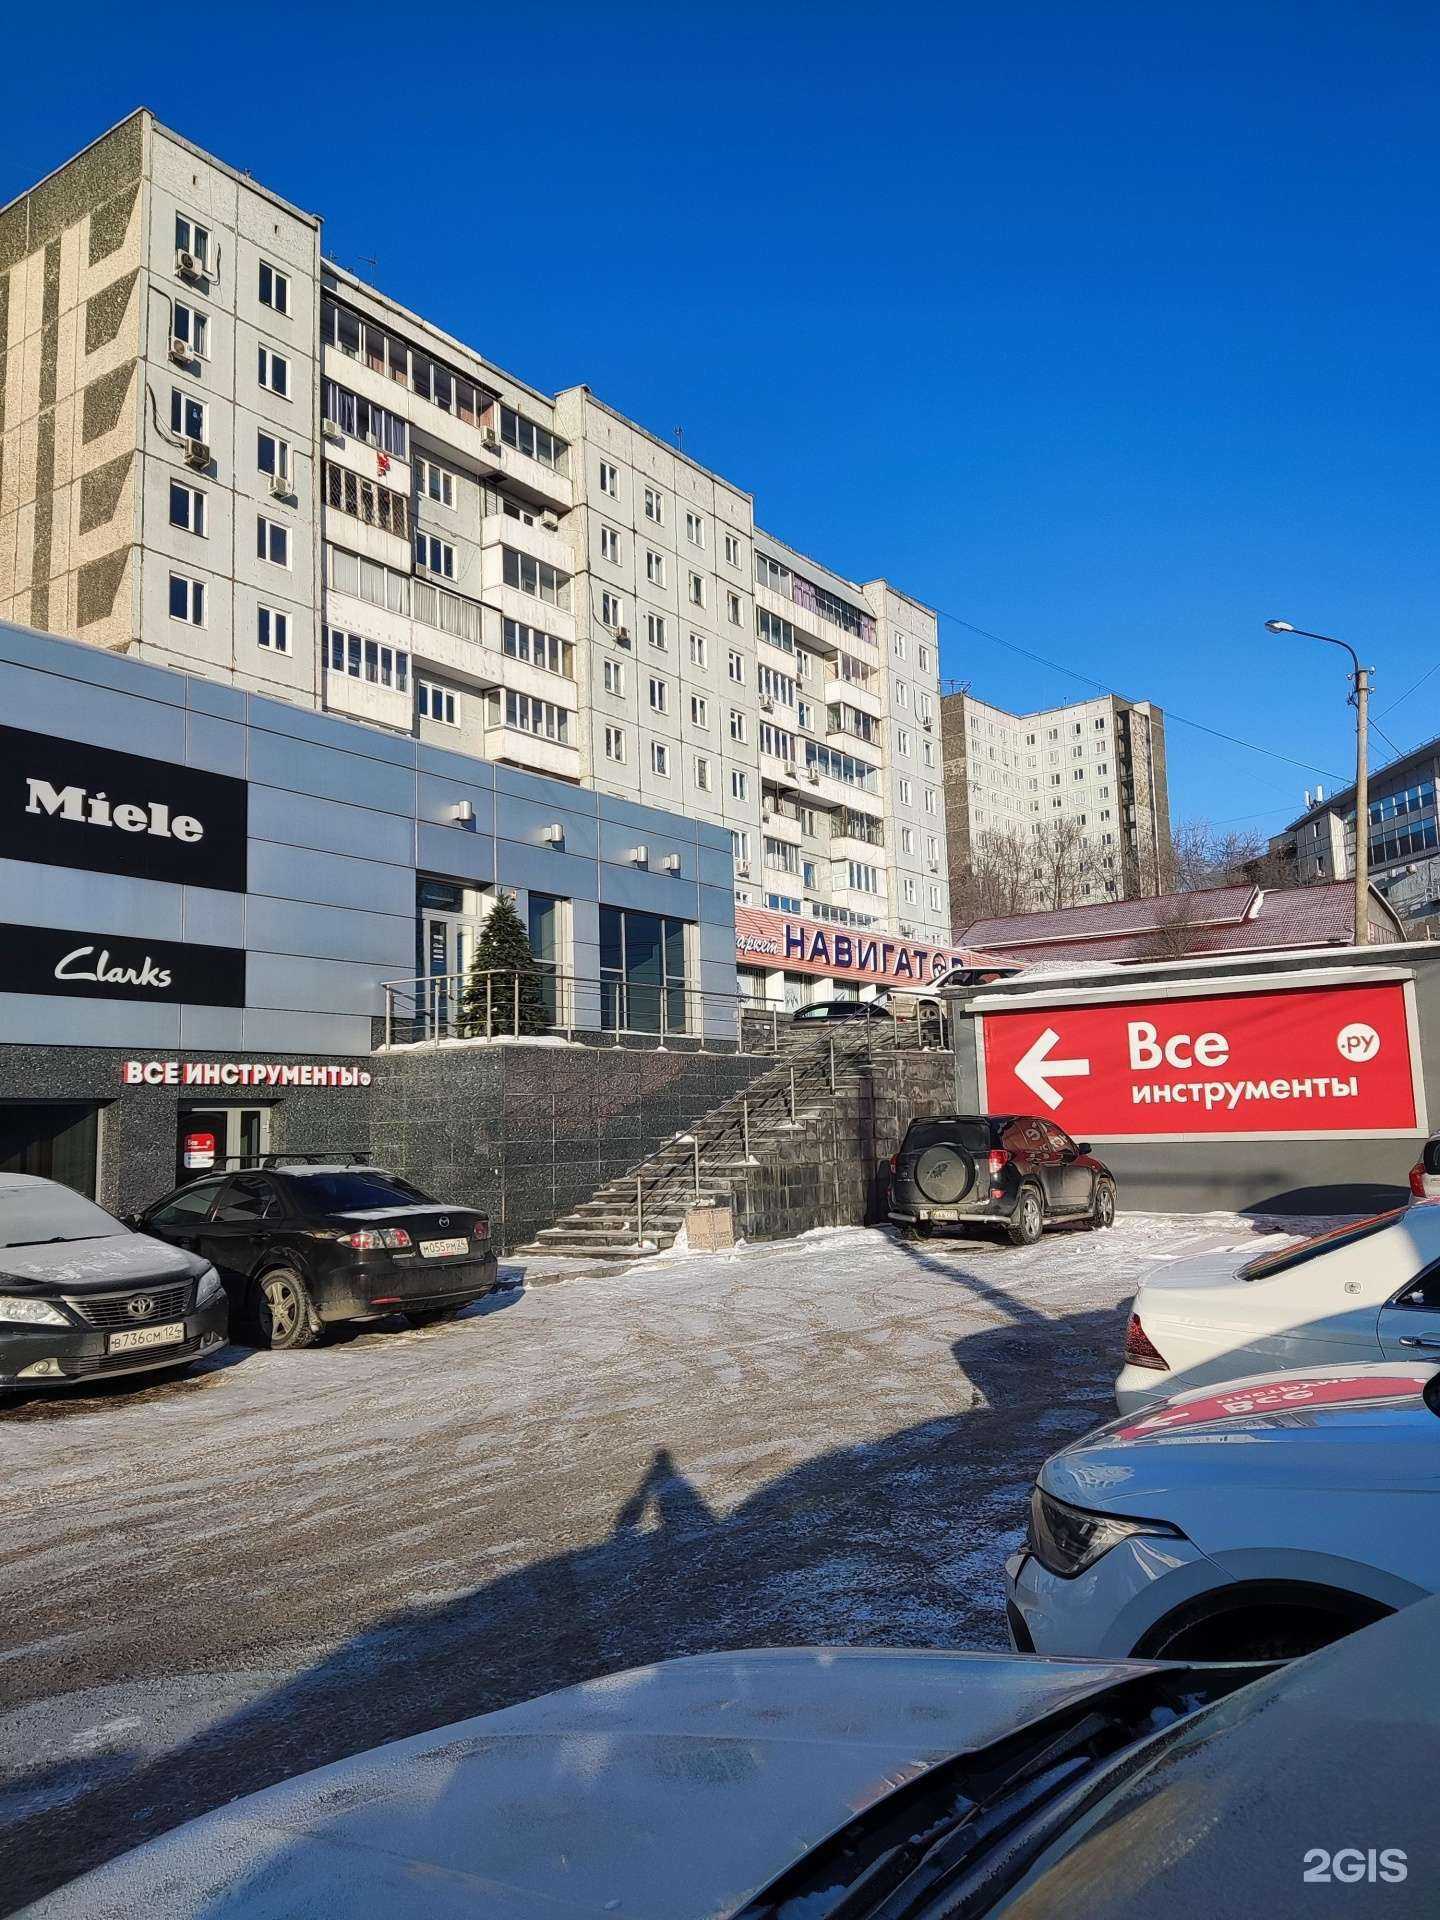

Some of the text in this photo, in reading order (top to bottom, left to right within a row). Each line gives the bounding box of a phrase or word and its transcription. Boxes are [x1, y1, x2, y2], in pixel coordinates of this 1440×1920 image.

[25, 777, 204, 843] Miele
[54, 946, 171, 987] Clarks
[1128, 1021, 1229, 1070] Все
[124, 1061, 179, 1085] ВСЕ
[184, 1063, 358, 1087] ИНСТРУМЕНТЫ
[1131, 1075, 1359, 1111] инструменты
